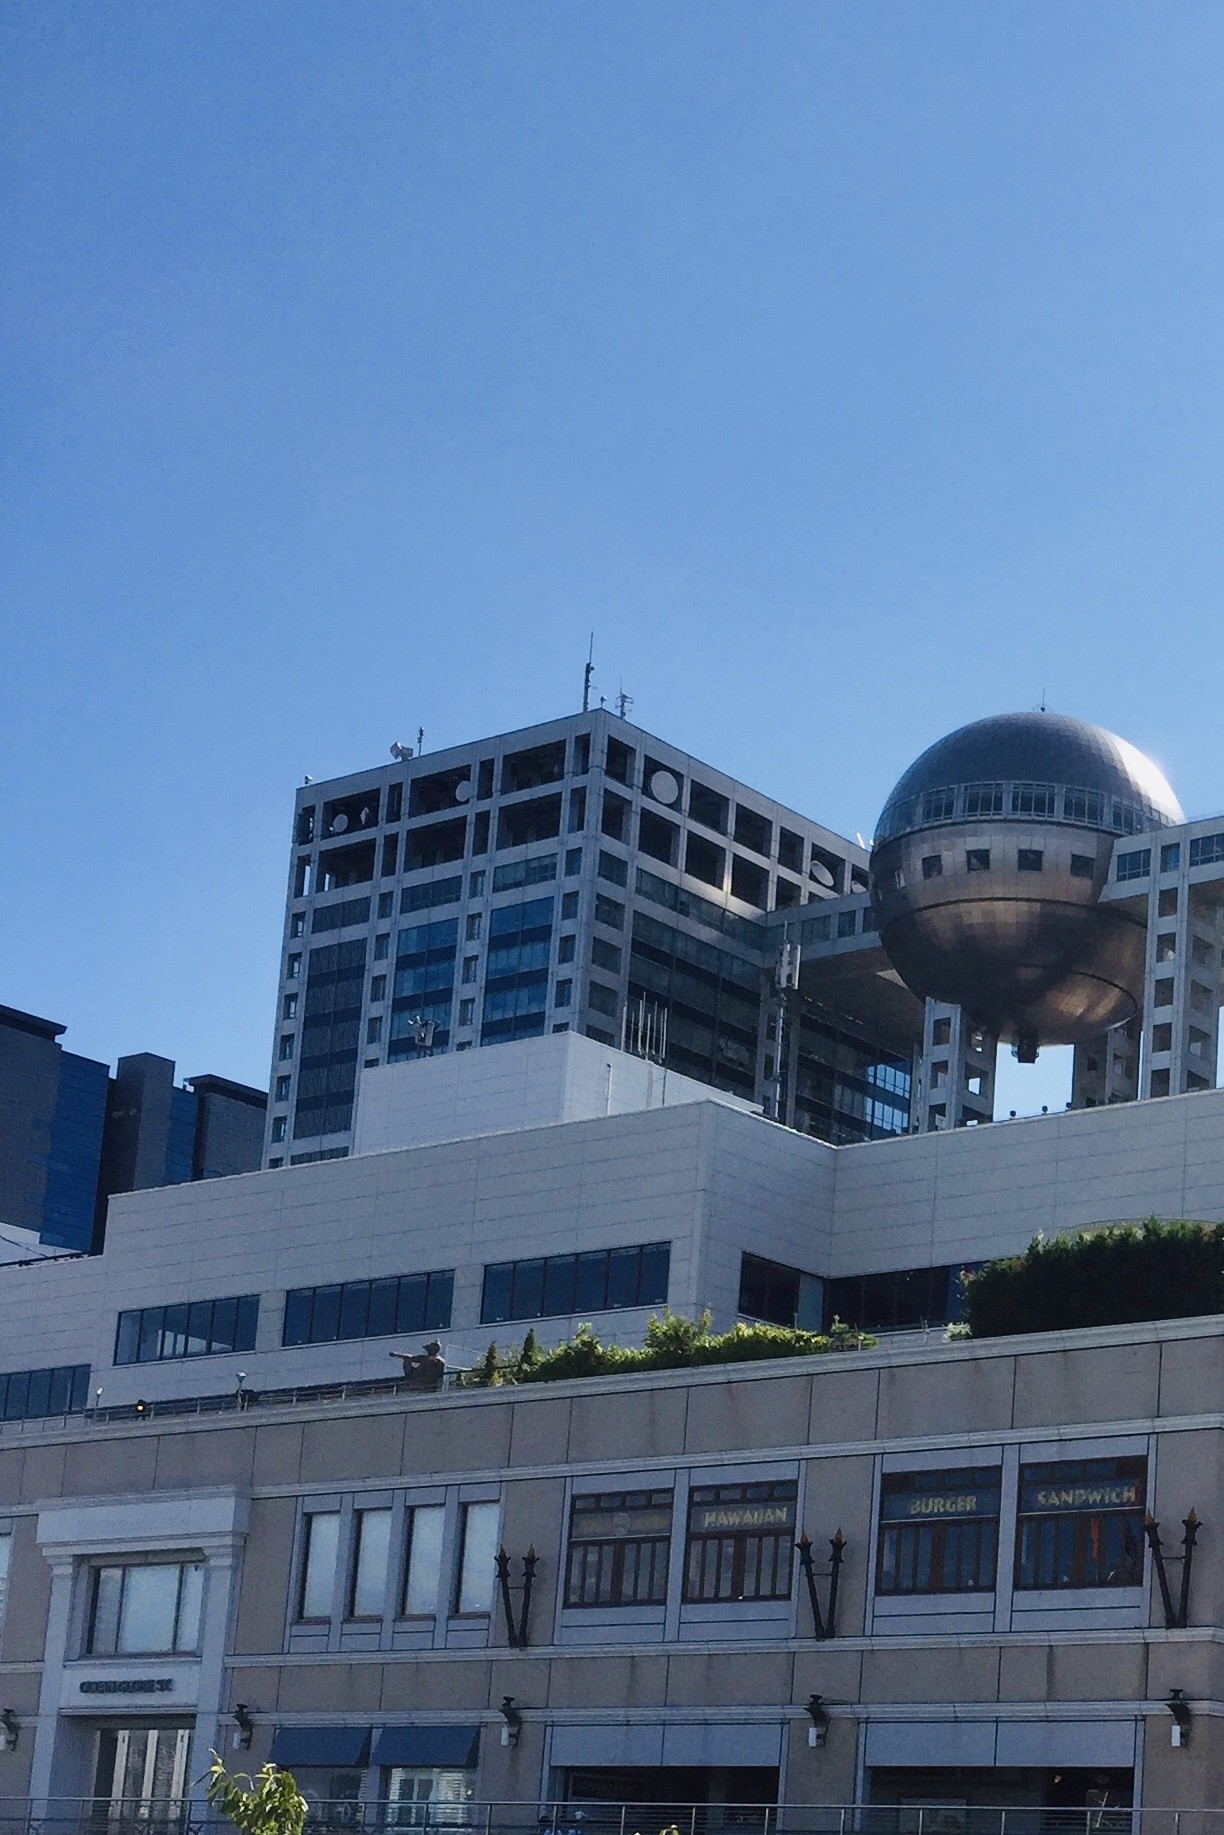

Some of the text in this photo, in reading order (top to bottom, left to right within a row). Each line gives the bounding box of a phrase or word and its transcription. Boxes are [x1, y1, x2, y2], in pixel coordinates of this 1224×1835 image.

[909, 1495, 978, 1514] BURGER
[1037, 1486, 1136, 1507] SANDWICH
[703, 1506, 788, 1529] HAWAIIAN
